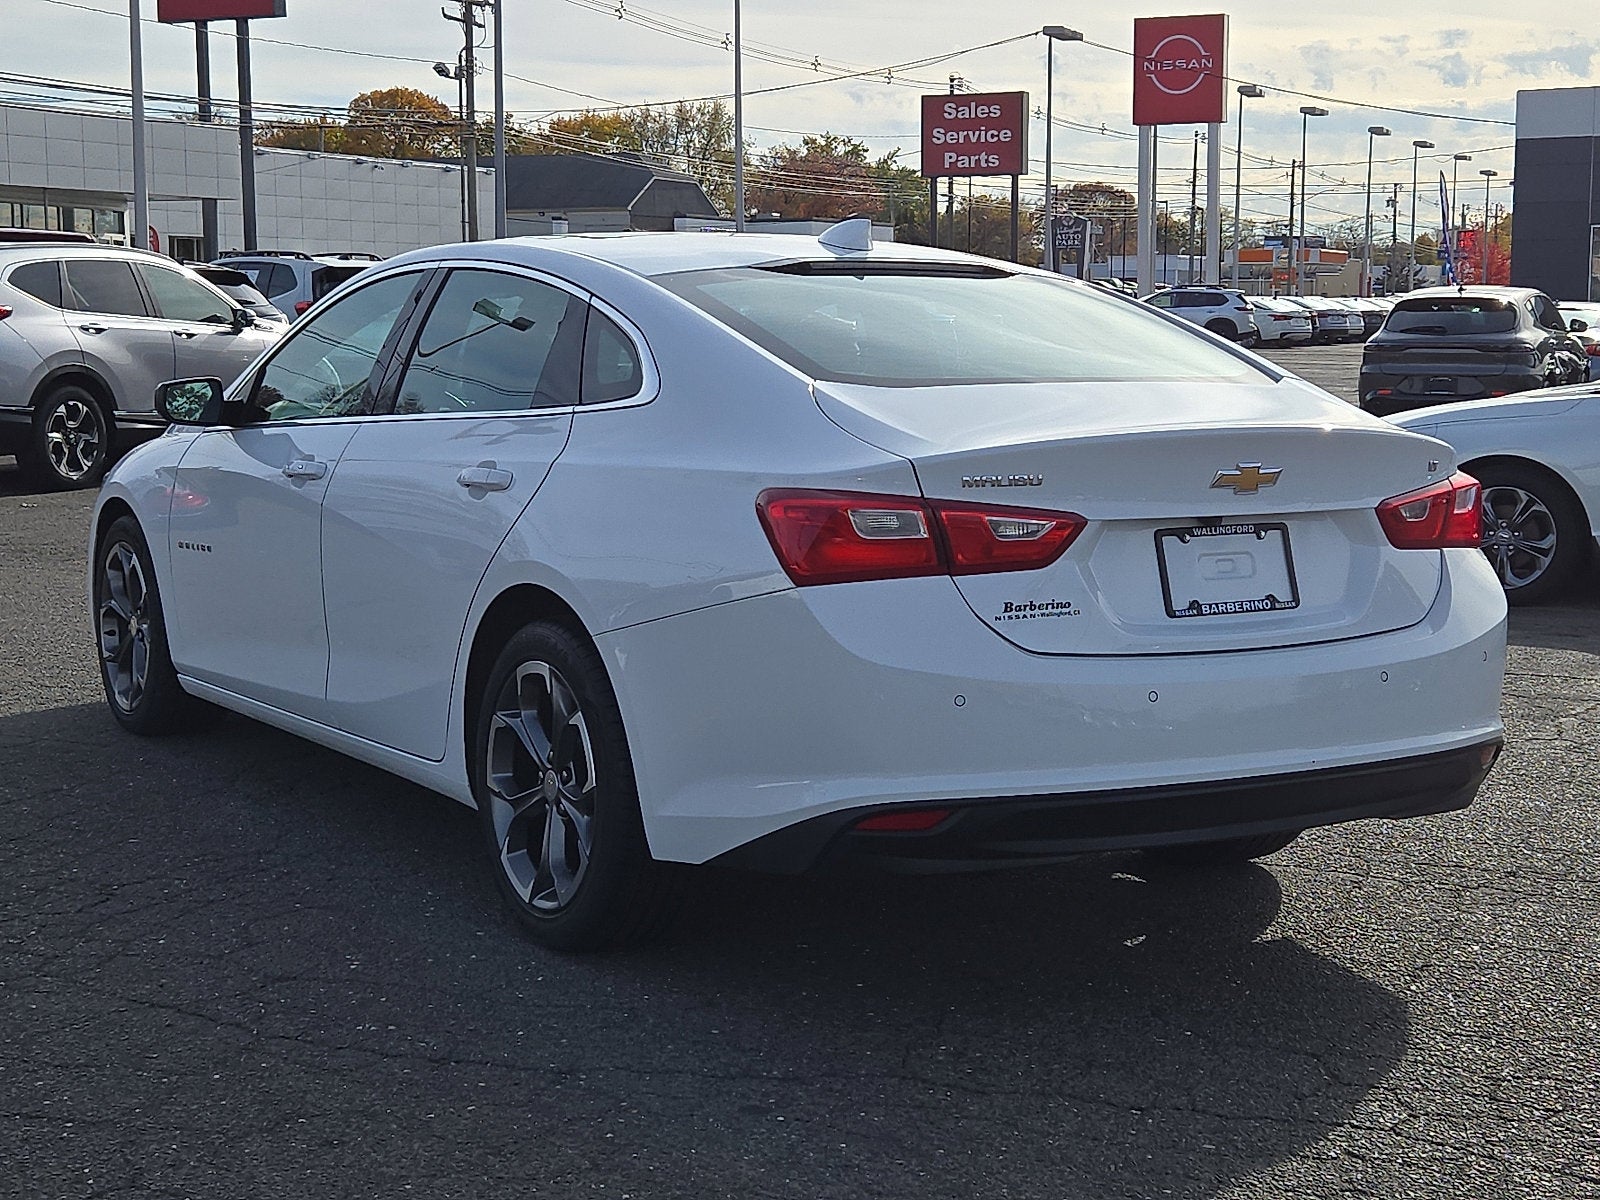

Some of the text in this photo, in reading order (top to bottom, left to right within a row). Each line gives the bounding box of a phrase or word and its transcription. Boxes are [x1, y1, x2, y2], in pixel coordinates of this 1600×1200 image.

[1143, 58, 1213, 71] NISSAN
[943, 101, 1001, 120] Sales
[932, 126, 1012, 144] Service
[944, 151, 1000, 169] Parts
[961, 474, 1043, 488] MALIBU
[1193, 525, 1255, 535] WALLINGFORD
[1002, 599, 1071, 613] Barberino
[1175, 608, 1198, 617] NISSAN
[1201, 600, 1271, 615] BARBERINO
[994, 613, 1036, 621] NISSAN
